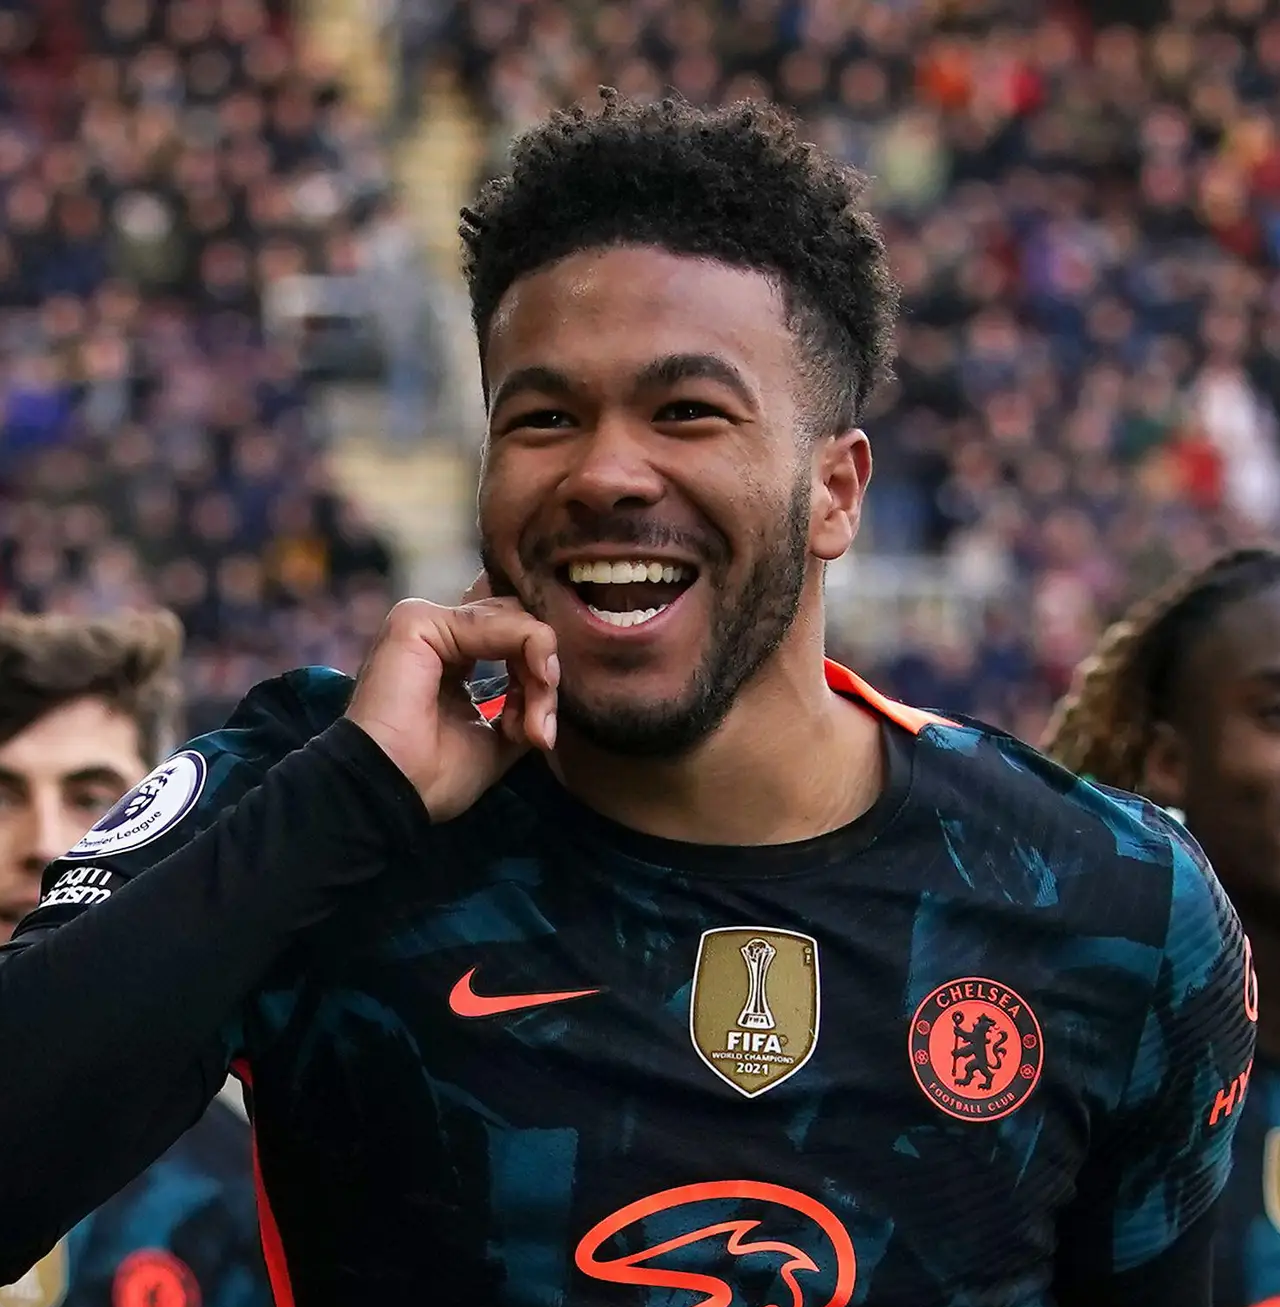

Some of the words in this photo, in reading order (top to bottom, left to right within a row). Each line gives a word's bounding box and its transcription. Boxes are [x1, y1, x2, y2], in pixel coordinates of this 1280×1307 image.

[116, 810, 162, 840] League
[936, 983, 1022, 1019] CHELSEA
[727, 1031, 782, 1054] FIFA
[711, 1051, 743, 1060] WORLD
[744, 1052, 795, 1064] CHAMPIONS
[736, 1062, 769, 1075] 2021
[928, 1081, 983, 1114] FOOTBALL
[987, 1092, 1016, 1112] CLUB
